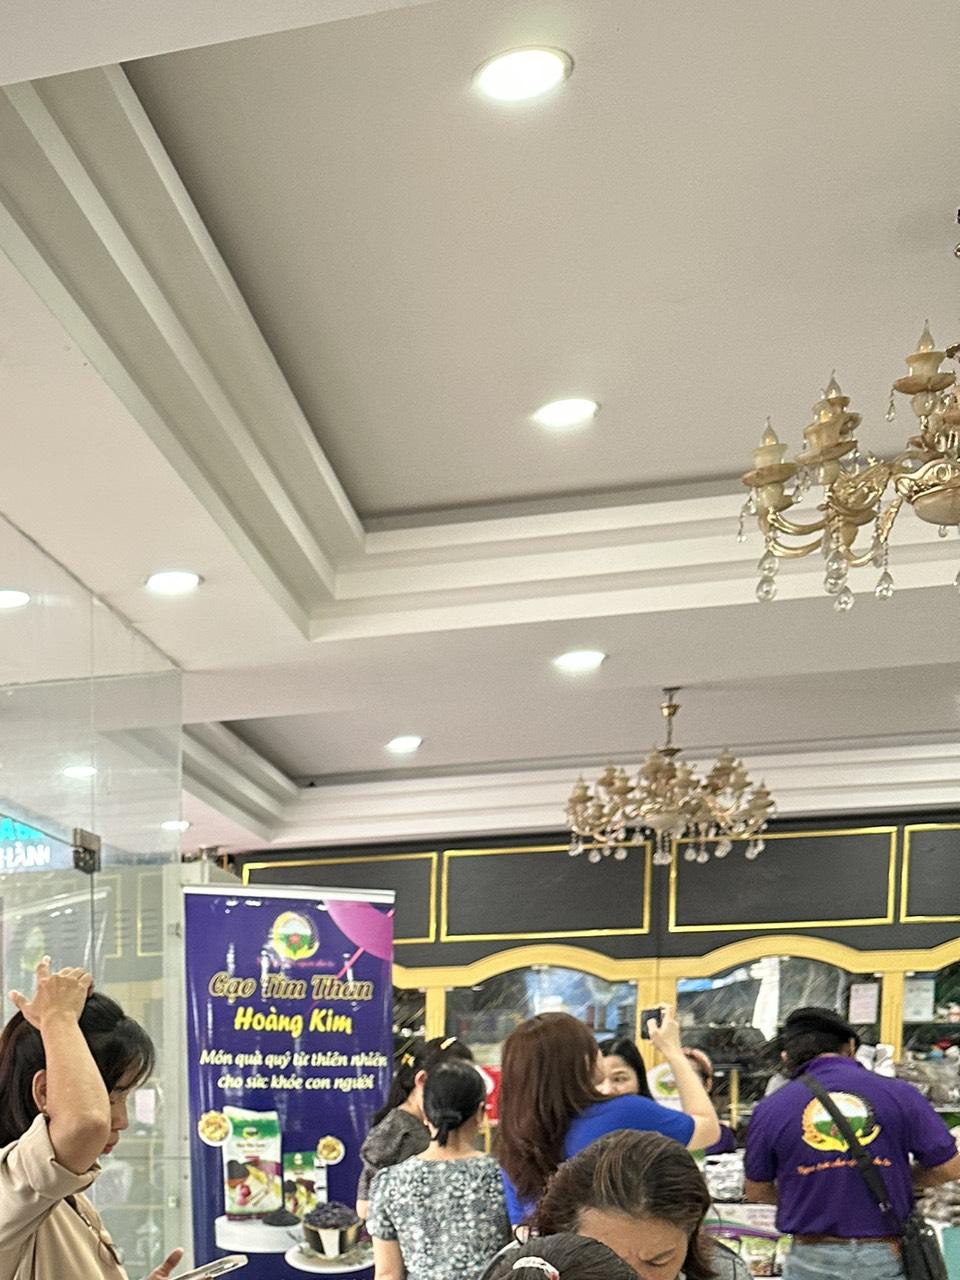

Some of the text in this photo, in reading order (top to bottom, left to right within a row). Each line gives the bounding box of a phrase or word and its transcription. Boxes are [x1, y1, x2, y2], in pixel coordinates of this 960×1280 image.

[208, 970, 257, 1005] Gạo
[234, 1005, 352, 1038] Hoàng Kim
[199, 1049, 233, 1066] Món
[235, 1050, 263, 1068] quà
[264, 1051, 291, 1069] quý
[311, 1051, 348, 1067] thiên
[350, 1052, 388, 1068] nhiên
[217, 1074, 244, 1089] cho
[245, 1073, 269, 1090] sức
[305, 1077, 332, 1091] con
[334, 1074, 375, 1093] người
